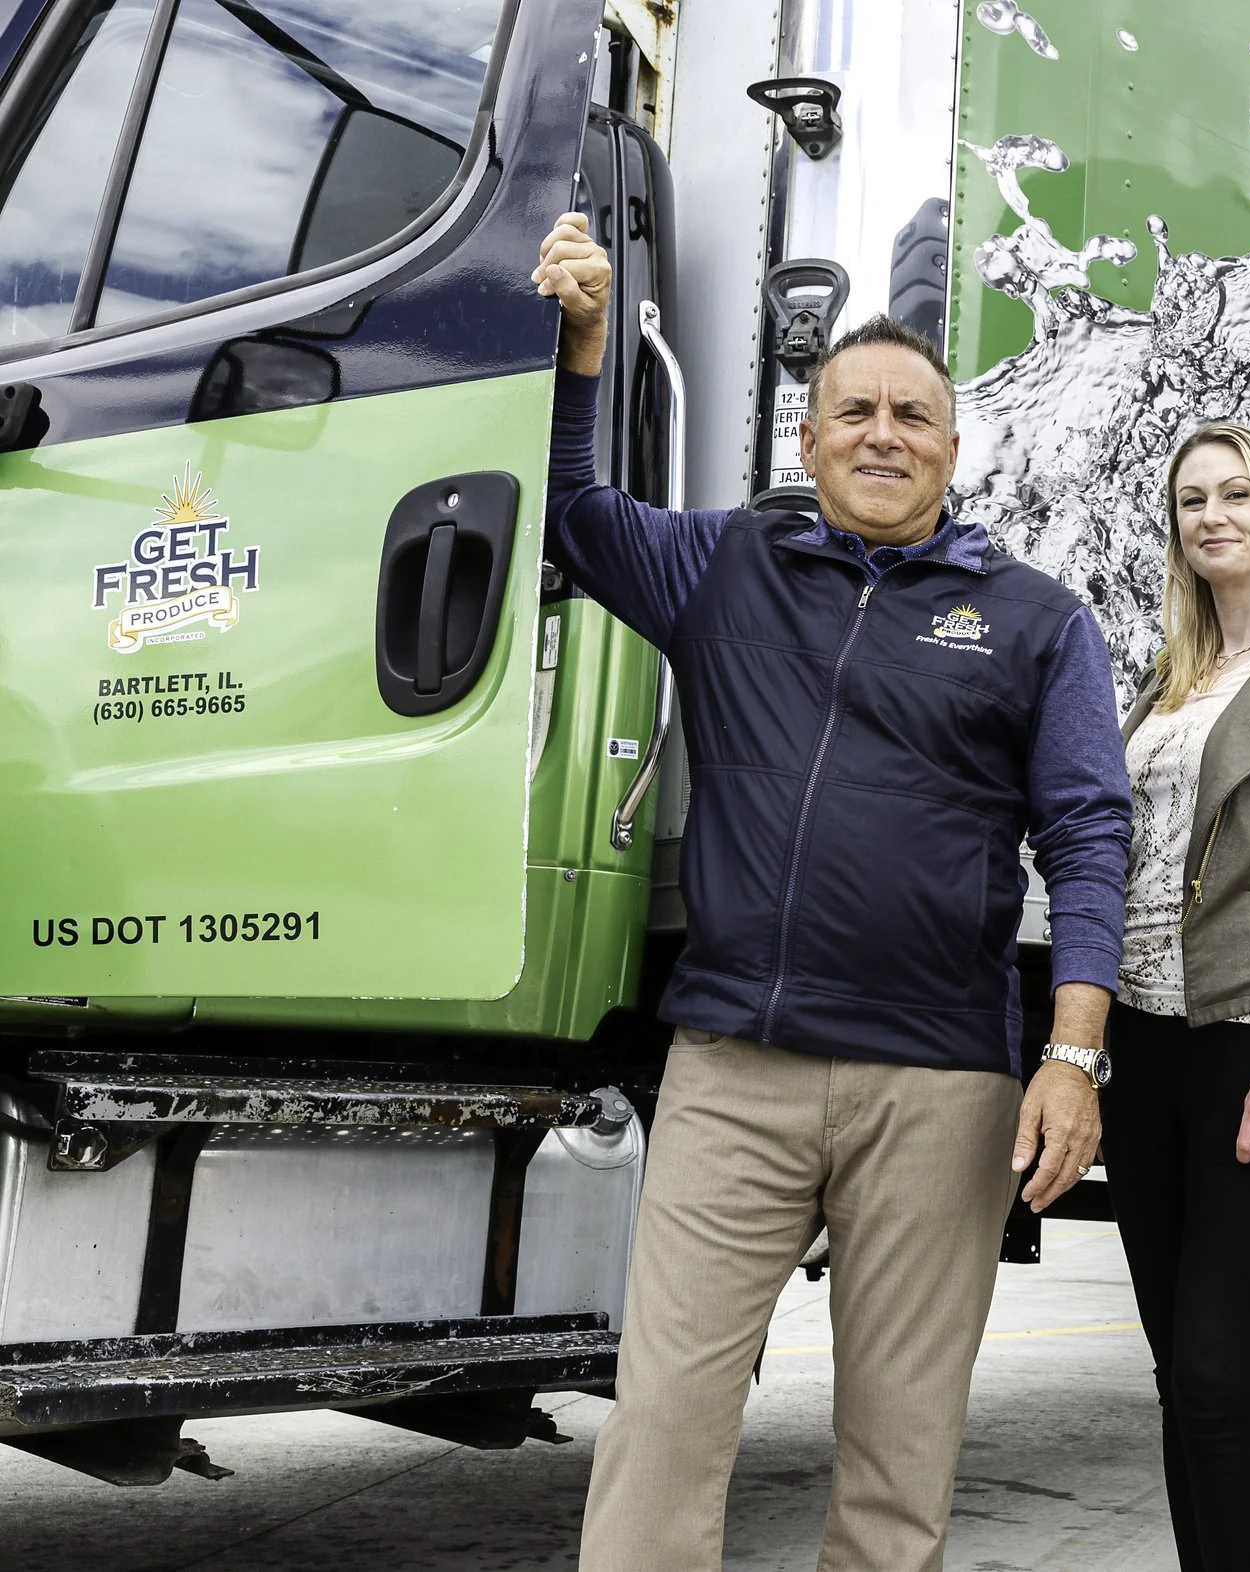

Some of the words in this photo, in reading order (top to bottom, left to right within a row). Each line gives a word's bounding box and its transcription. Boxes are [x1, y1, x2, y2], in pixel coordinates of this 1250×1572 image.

[775, 411, 808, 424] VERTI
[134, 520, 228, 565] GET
[94, 549, 258, 607] FRESH
[131, 592, 220, 626] PRODUCE
[947, 613, 982, 625] GET
[931, 615, 990, 634] FRESH
[147, 632, 205, 644] INCORPORATED
[915, 635, 939, 645] Fresh
[948, 642, 994, 655] Everything
[98, 673, 210, 697] BARTLETT,
[218, 671, 243, 690] IL.
[93, 700, 144, 726] (630)
[151, 694, 245, 718] 665-9665
[33, 918, 79, 947] US
[92, 915, 167, 945] DOT
[179, 911, 320, 943] 1305291
